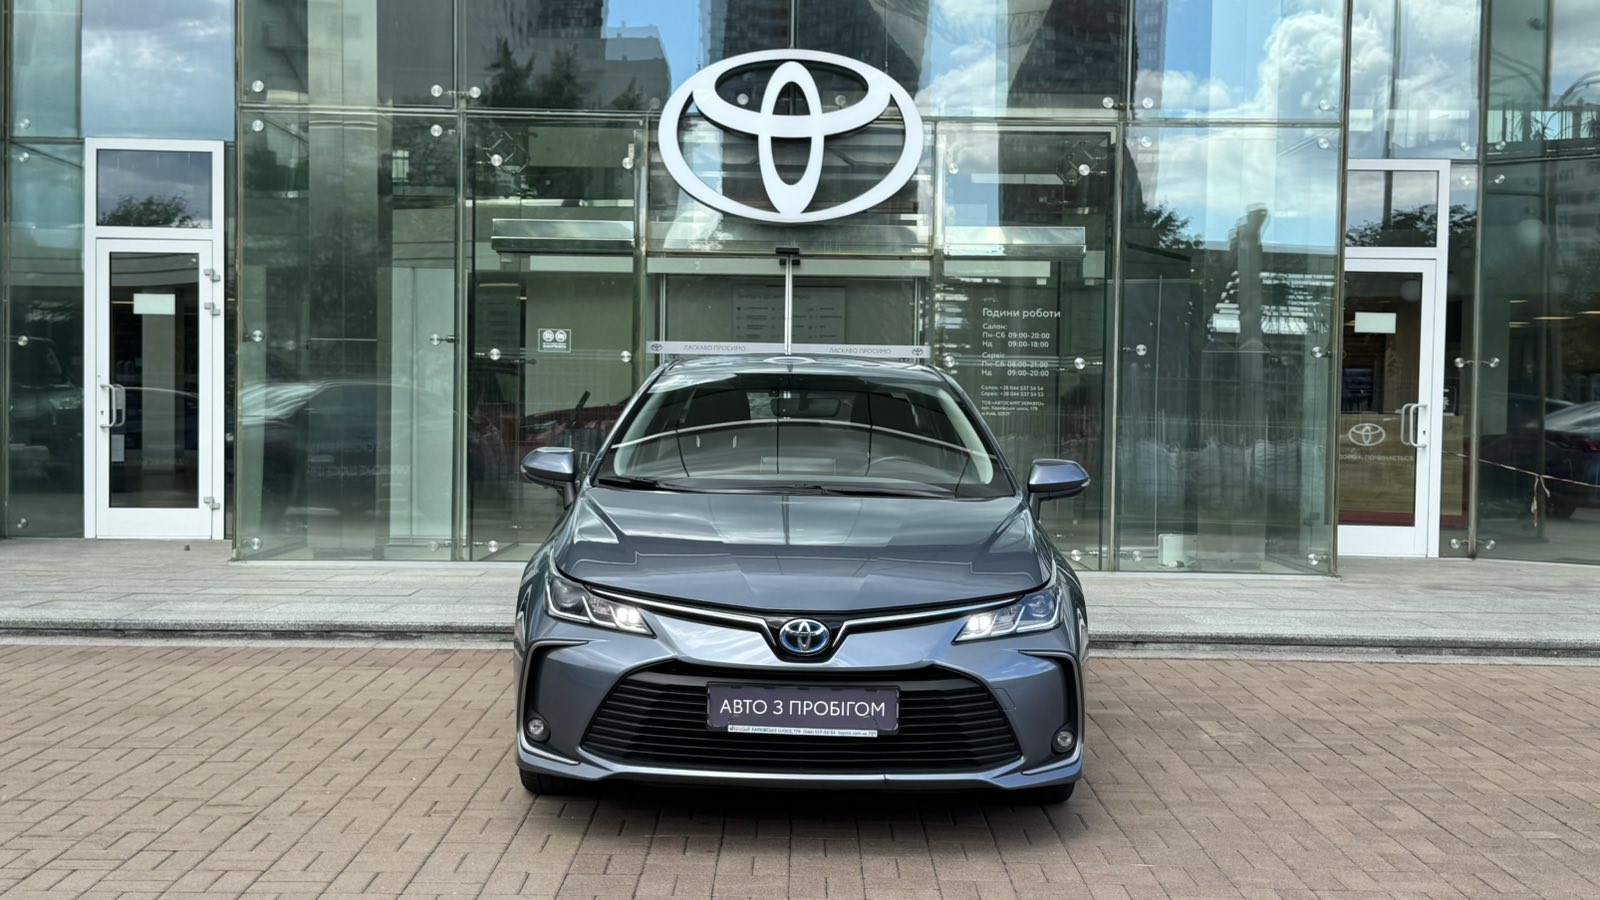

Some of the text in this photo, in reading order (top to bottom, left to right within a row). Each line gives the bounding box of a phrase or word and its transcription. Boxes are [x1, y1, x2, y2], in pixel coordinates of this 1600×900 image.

[982, 308, 1061, 319] Години роботи
[1007, 332, 1050, 340] 09:00-20:00
[1007, 369, 1050, 377] 09:00-20:00
[719, 698, 768, 715] АВТО
[789, 701, 886, 717] ПРОБІГОМ
